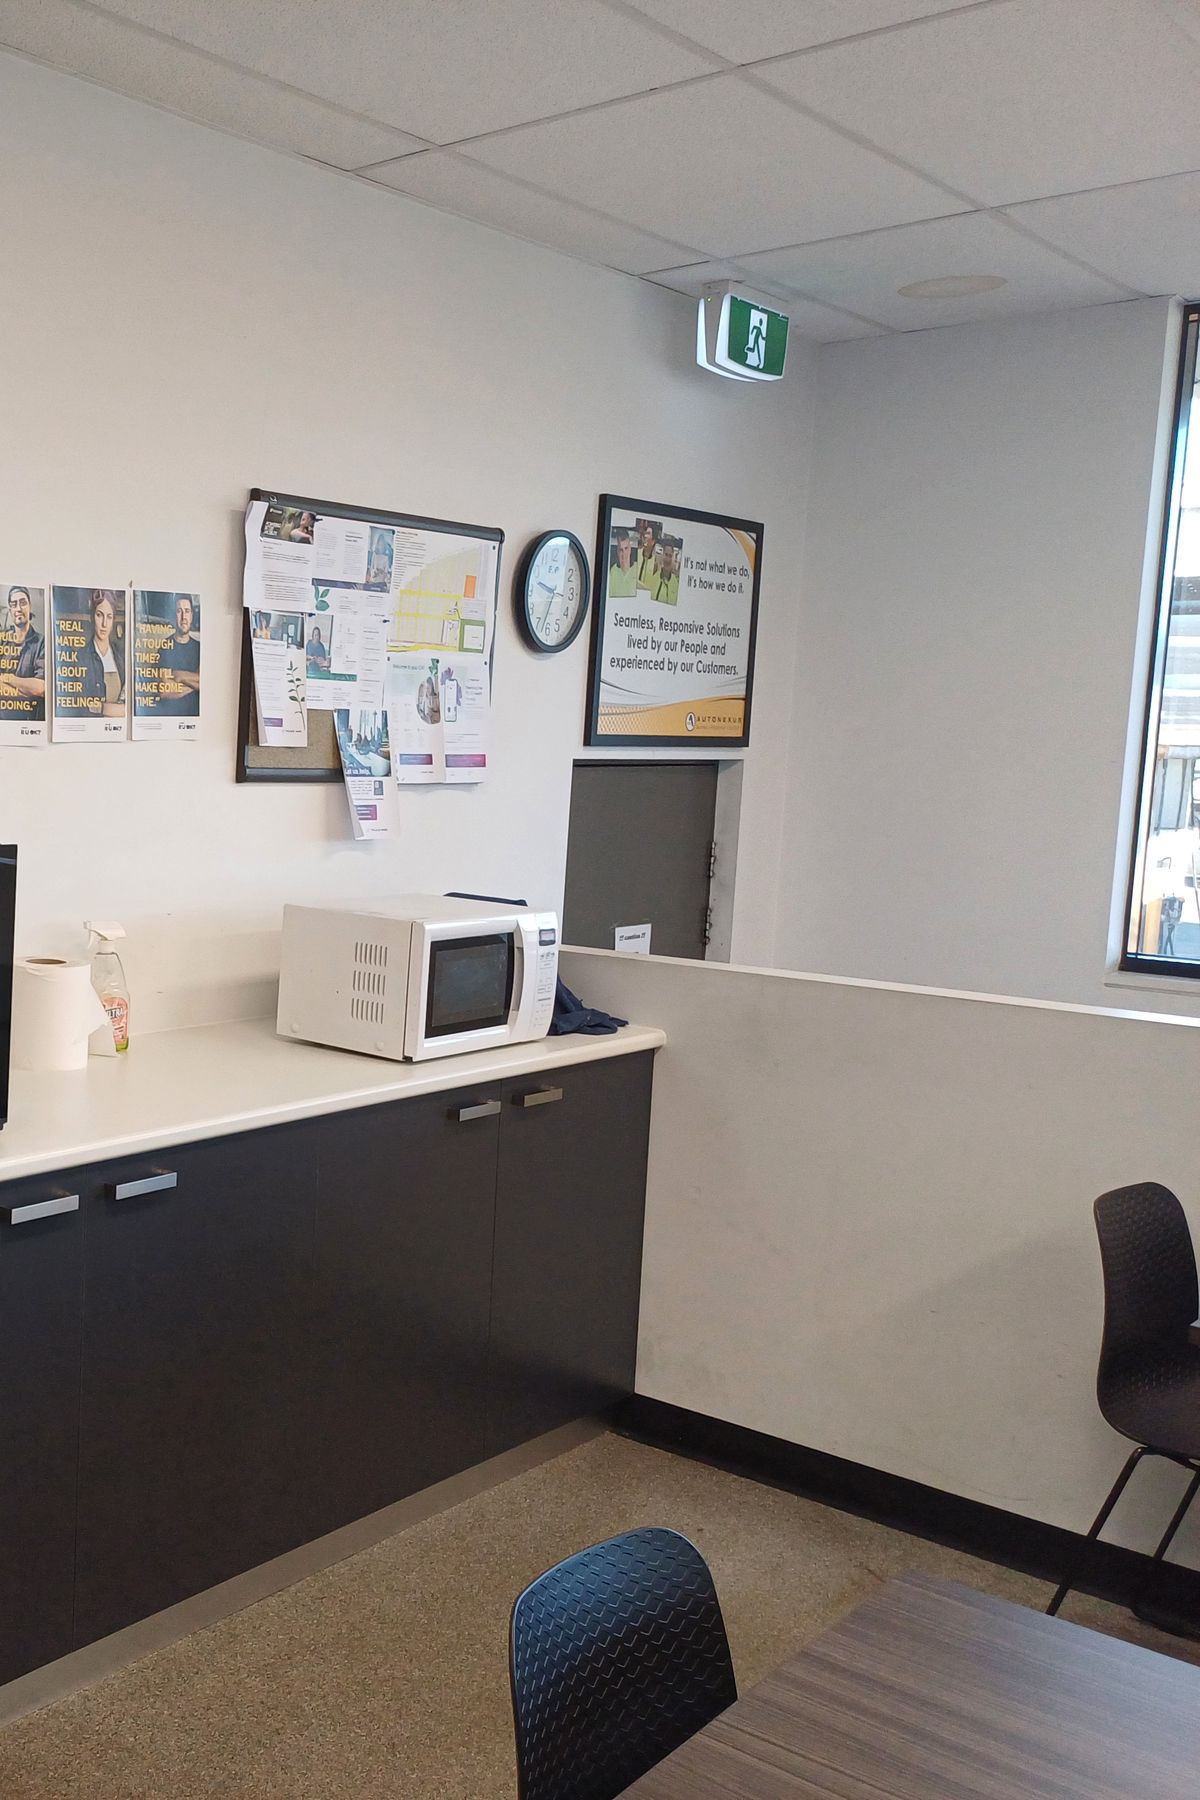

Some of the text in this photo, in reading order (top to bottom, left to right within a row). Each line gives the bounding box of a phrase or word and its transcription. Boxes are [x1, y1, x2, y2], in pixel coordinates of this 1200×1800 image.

[684, 557, 750, 579] It's not what we do,
[567, 568, 573, 583] 2
[699, 577, 714, 590] how
[716, 582, 726, 592] we
[727, 582, 737, 593] do
[568, 587, 575, 602] 3
[563, 606, 569, 619] 4
[535, 616, 541, 631] 7
[545, 622, 551, 636] 6
[554, 619, 560, 633] 5
[614, 612, 740, 639] Seamless, Responsive Solutions
[56, 636, 86, 648] MATES
[135, 638, 174, 650] A TOUGH
[627, 634, 726, 657] lived by our People and
[56, 650, 78, 662] TALK
[135, 652, 161, 664] TIME?
[0, 660, 19, 669] BUT
[610, 655, 739, 676] experienced by our Customers.
[56, 666, 87, 678] ABOUT
[135, 667, 174, 679] THEN I'LL
[56, 681, 83, 693] THEIR
[135, 682, 184, 693] MAKE SOME
